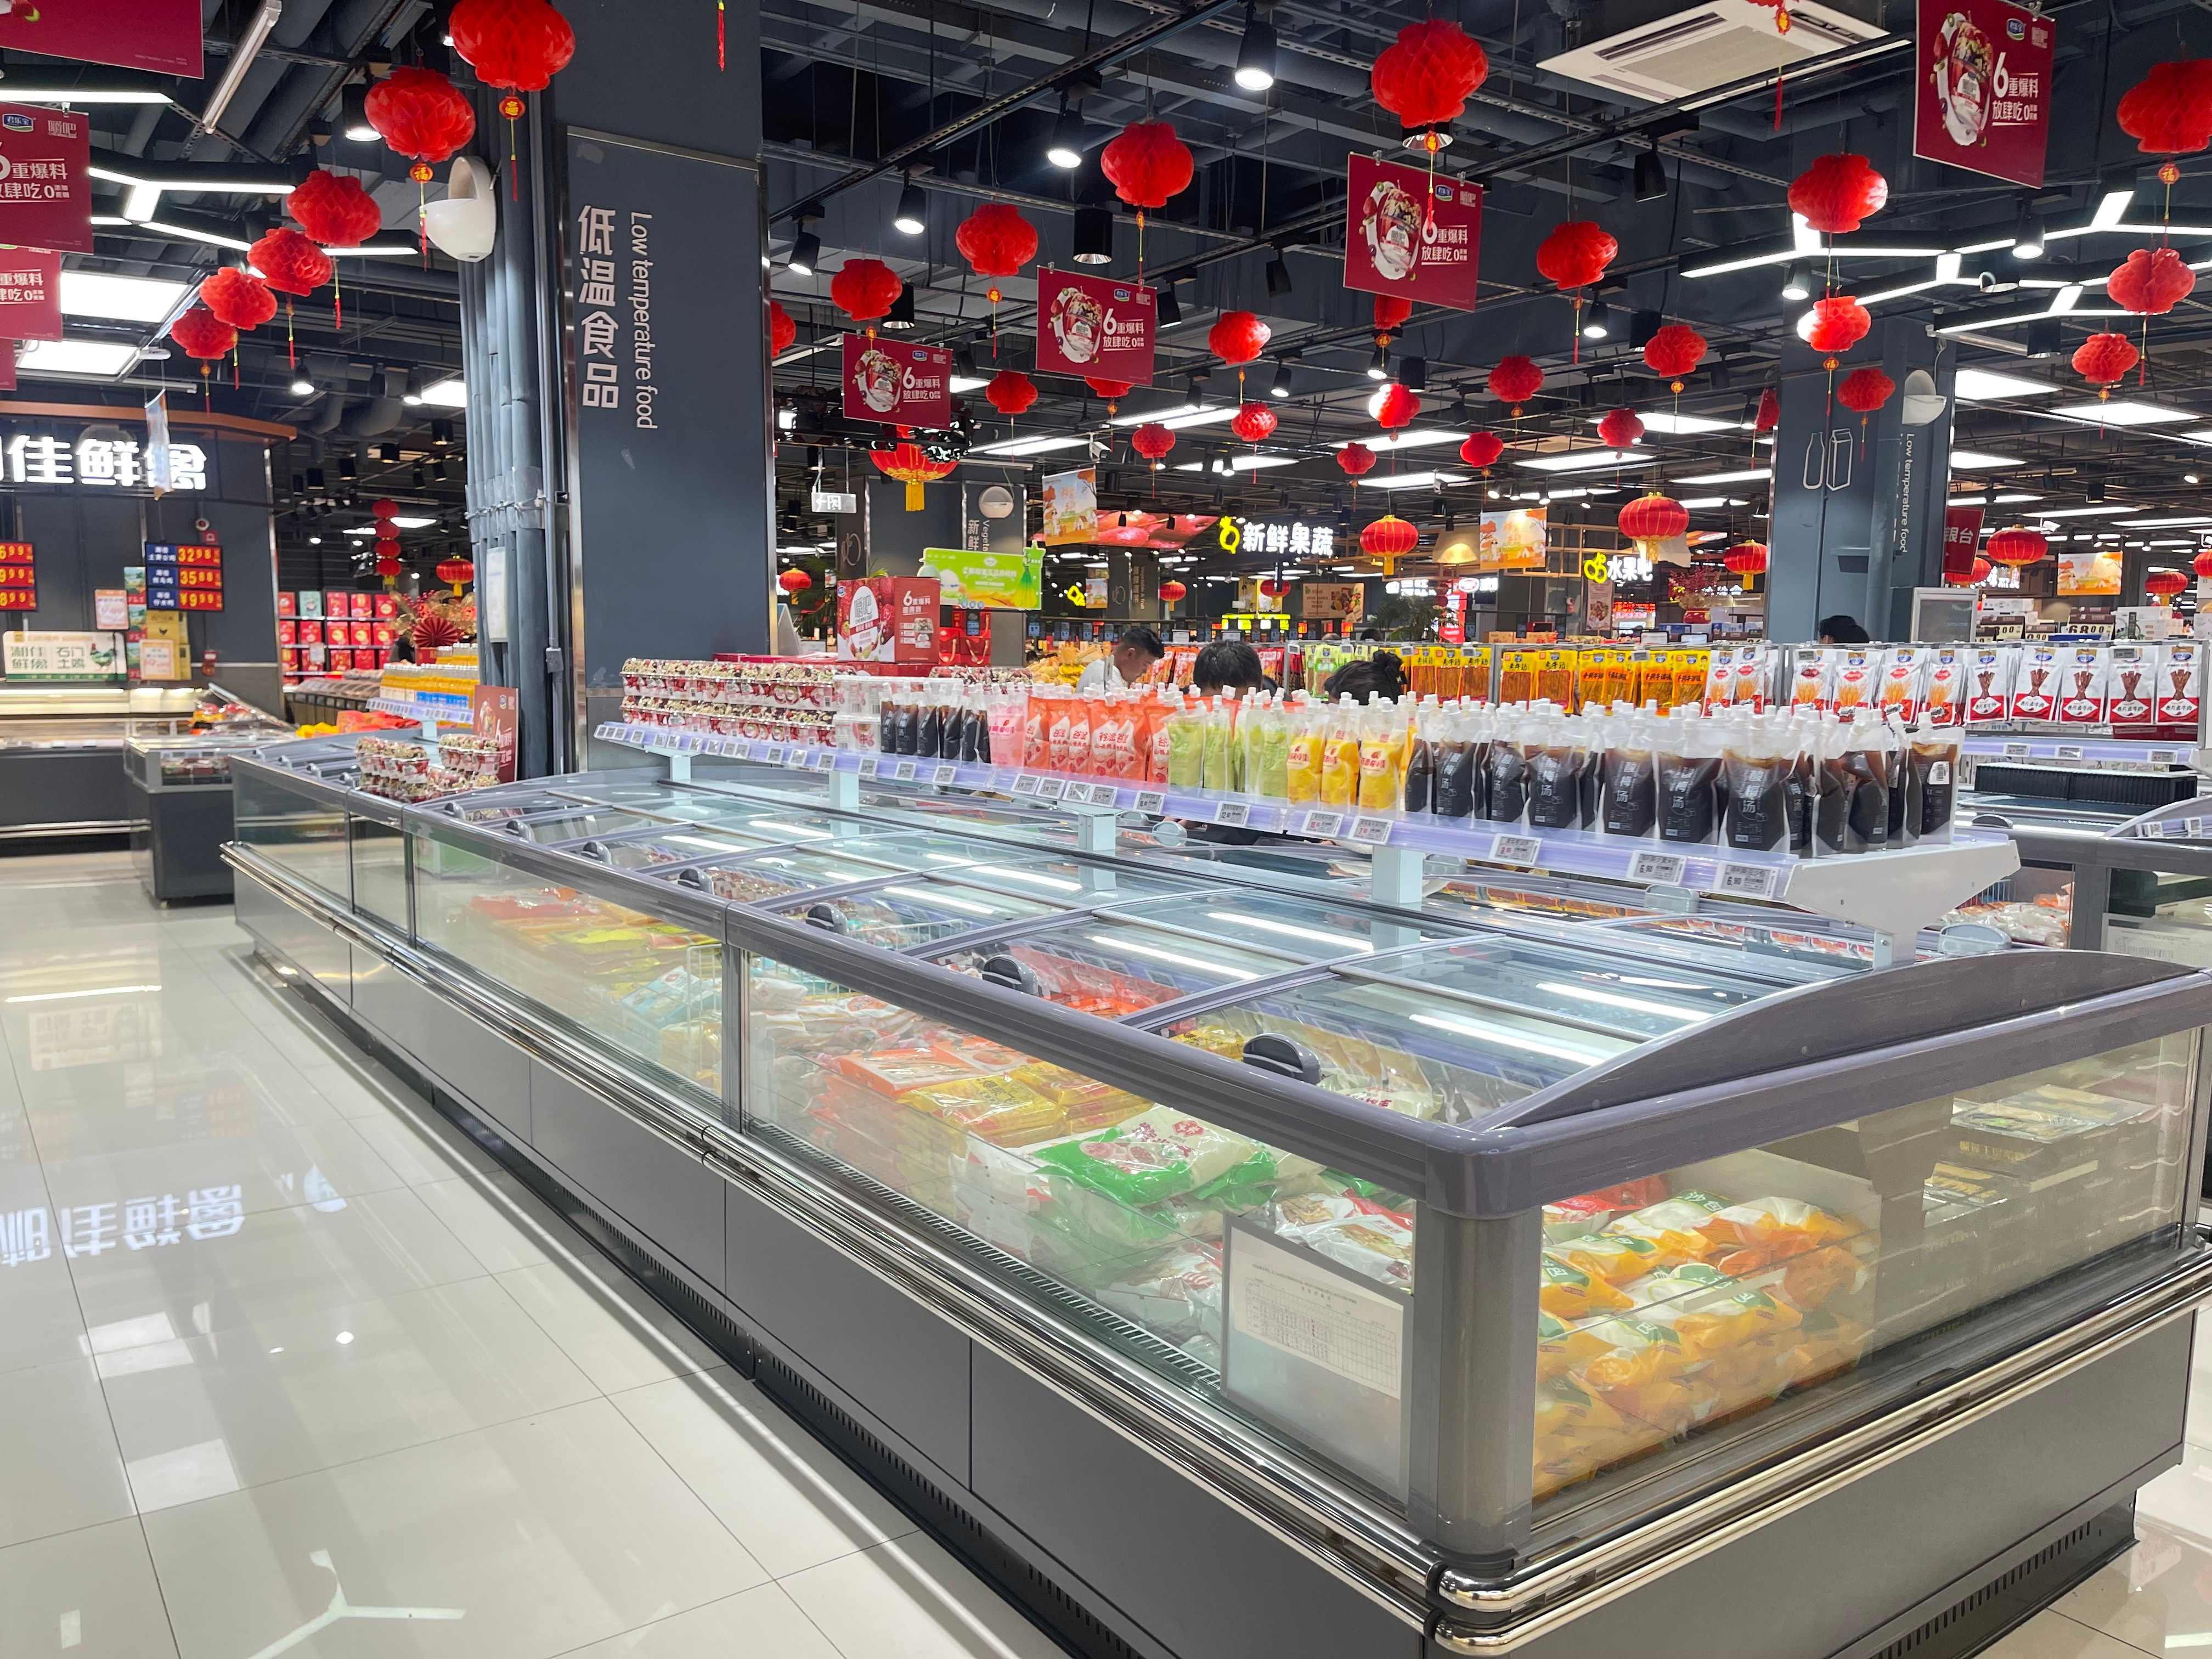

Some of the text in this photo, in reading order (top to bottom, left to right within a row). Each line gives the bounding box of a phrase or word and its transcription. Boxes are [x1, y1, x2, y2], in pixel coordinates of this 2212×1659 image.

[1994, 52, 2039, 98] 6重爆料
[415, 167, 428, 180] 福
[2162, 167, 2176, 181] 福
[578, 205, 619, 409] 低温食品
[628, 211, 658, 429] Low temperature food
[1103, 308, 1144, 335] 6重爆料
[902, 366, 940, 389] 6重爆料
[0, 435, 206, 490] 佳鲜禽
[1900, 433, 1915, 554] Low temperature food
[1242, 522, 1334, 556] 新鲜果蔬
[1607, 555, 1653, 582] 水果吧
[57, 646, 84, 657] 石门
[1616, 761, 1638, 803] 酸梅汤
[1742, 770, 1765, 814] 酸梅汤
[1726, 876, 1741, 885] 6.90
